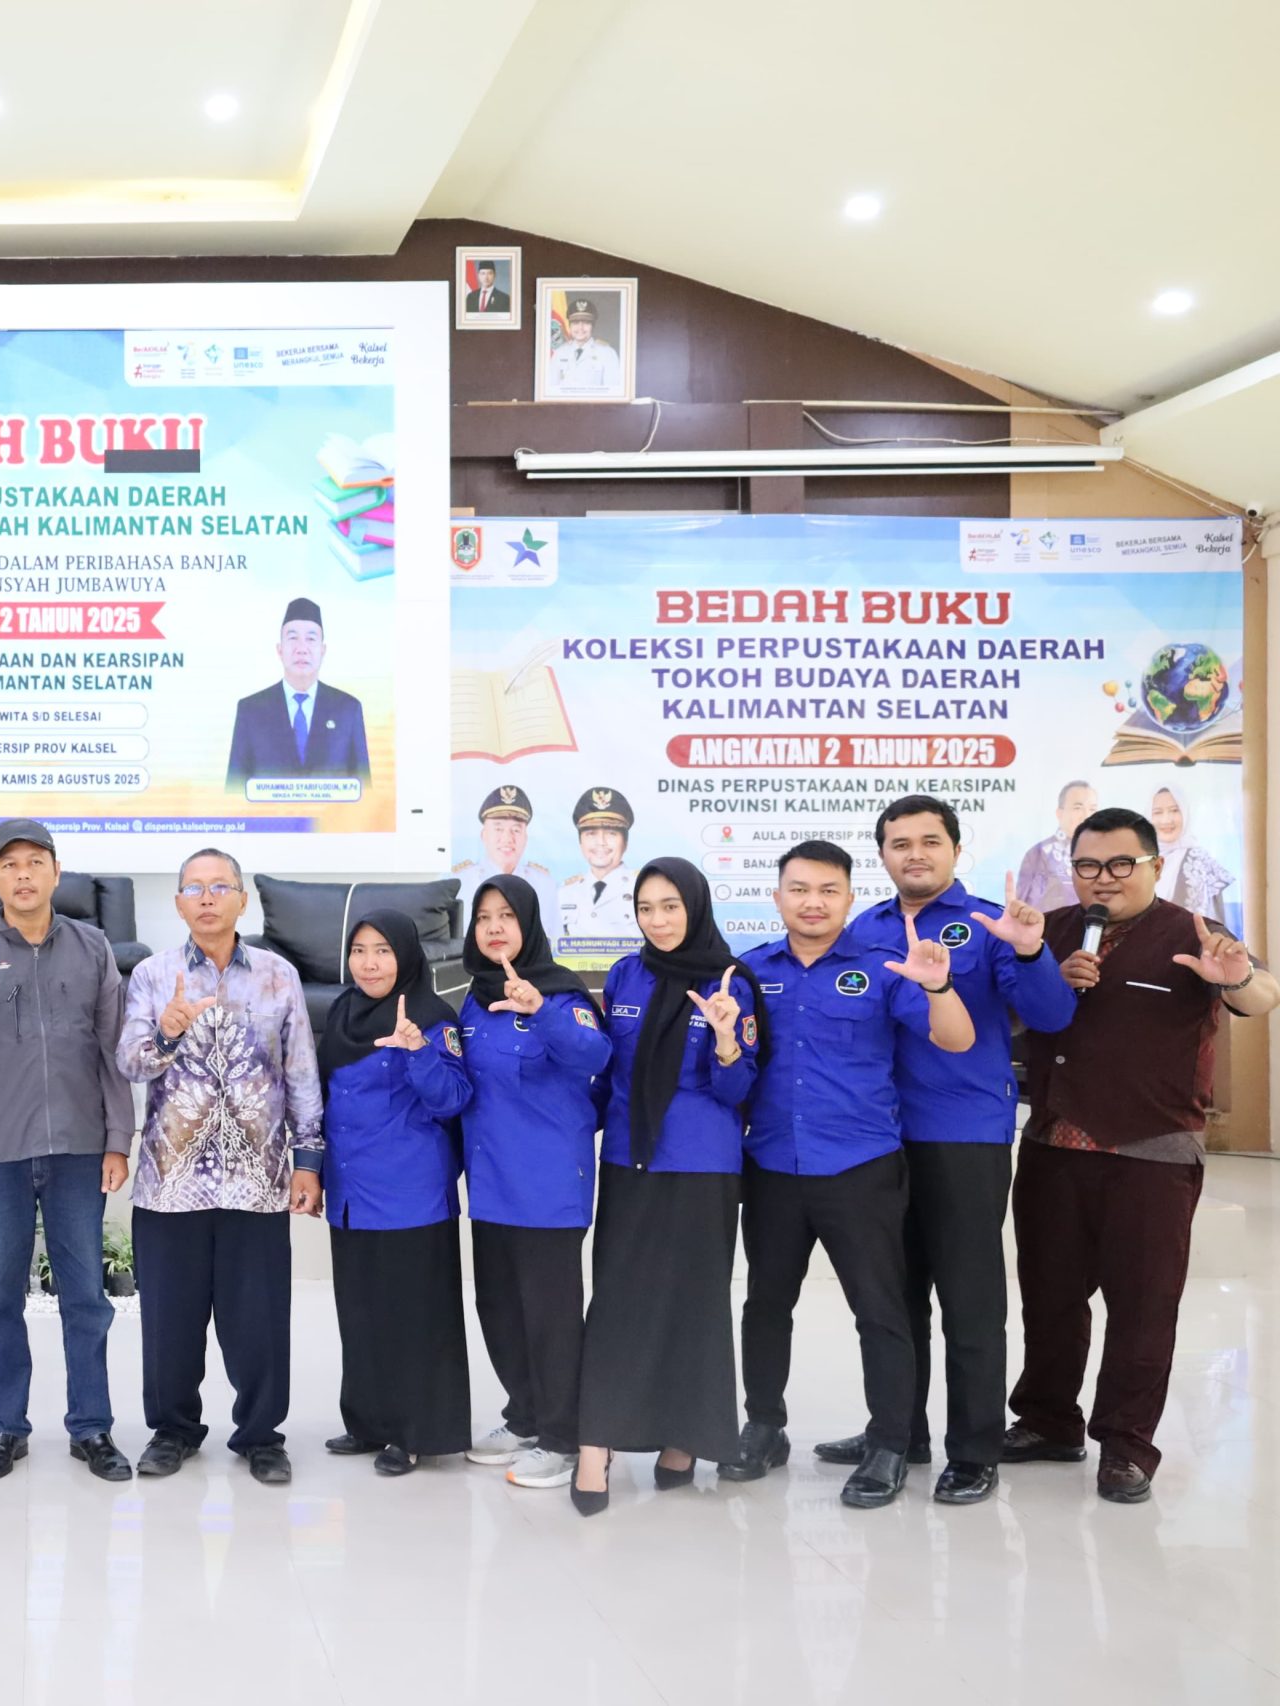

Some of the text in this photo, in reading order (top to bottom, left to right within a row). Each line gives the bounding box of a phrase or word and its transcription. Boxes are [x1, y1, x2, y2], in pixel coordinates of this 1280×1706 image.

[40, 418, 204, 464] BUKU
[128, 486, 226, 506] DAERAH
[38, 516, 192, 536] KALIMANTAN
[201, 515, 308, 535] SELATAN
[66, 556, 174, 570] PERIBAHASA
[181, 555, 247, 573] BANJAR
[56, 577, 166, 594] JUMBAWUYA
[656, 590, 1011, 625] BEDAH BUKU
[0, 608, 12, 632] 2
[18, 608, 83, 632] TAHUN
[88, 608, 141, 632] 2025
[563, 638, 1105, 660] KOLEKSI PERPUSTAKAAN DAERAH
[41, 653, 76, 667] DAN
[83, 653, 184, 667] KEARSIPAN
[72, 675, 153, 690] SELATAN
[652, 667, 1021, 689] TOKOH BUDAYA DAERAH
[0, 711, 28, 721] WITA
[32, 711, 51, 721] S/D
[54, 711, 102, 721] SELESAI
[663, 698, 1009, 720] KALIMANTAN SELATAN
[35, 743, 66, 753] PROV
[72, 743, 117, 753] KALSEL
[688, 738, 996, 765] ANGKATAN 2 TAHUN 2025
[3, 774, 36, 785] KAMIS
[41, 774, 54, 785] 28
[58, 774, 111, 785] AGUSTUS
[115, 774, 140, 785] 2025
[658, 779, 1016, 793] DINAS PERPUSTAKAAN DAN KEARSIPAN
[689, 798, 898, 813] PROVINSI KALIMANTA
[753, 831, 786, 841] AULA
[790, 831, 853, 841] DISPERSIP
[866, 858, 878, 868] 28
[736, 887, 761, 897] JAM
[726, 922, 766, 932] DANA
